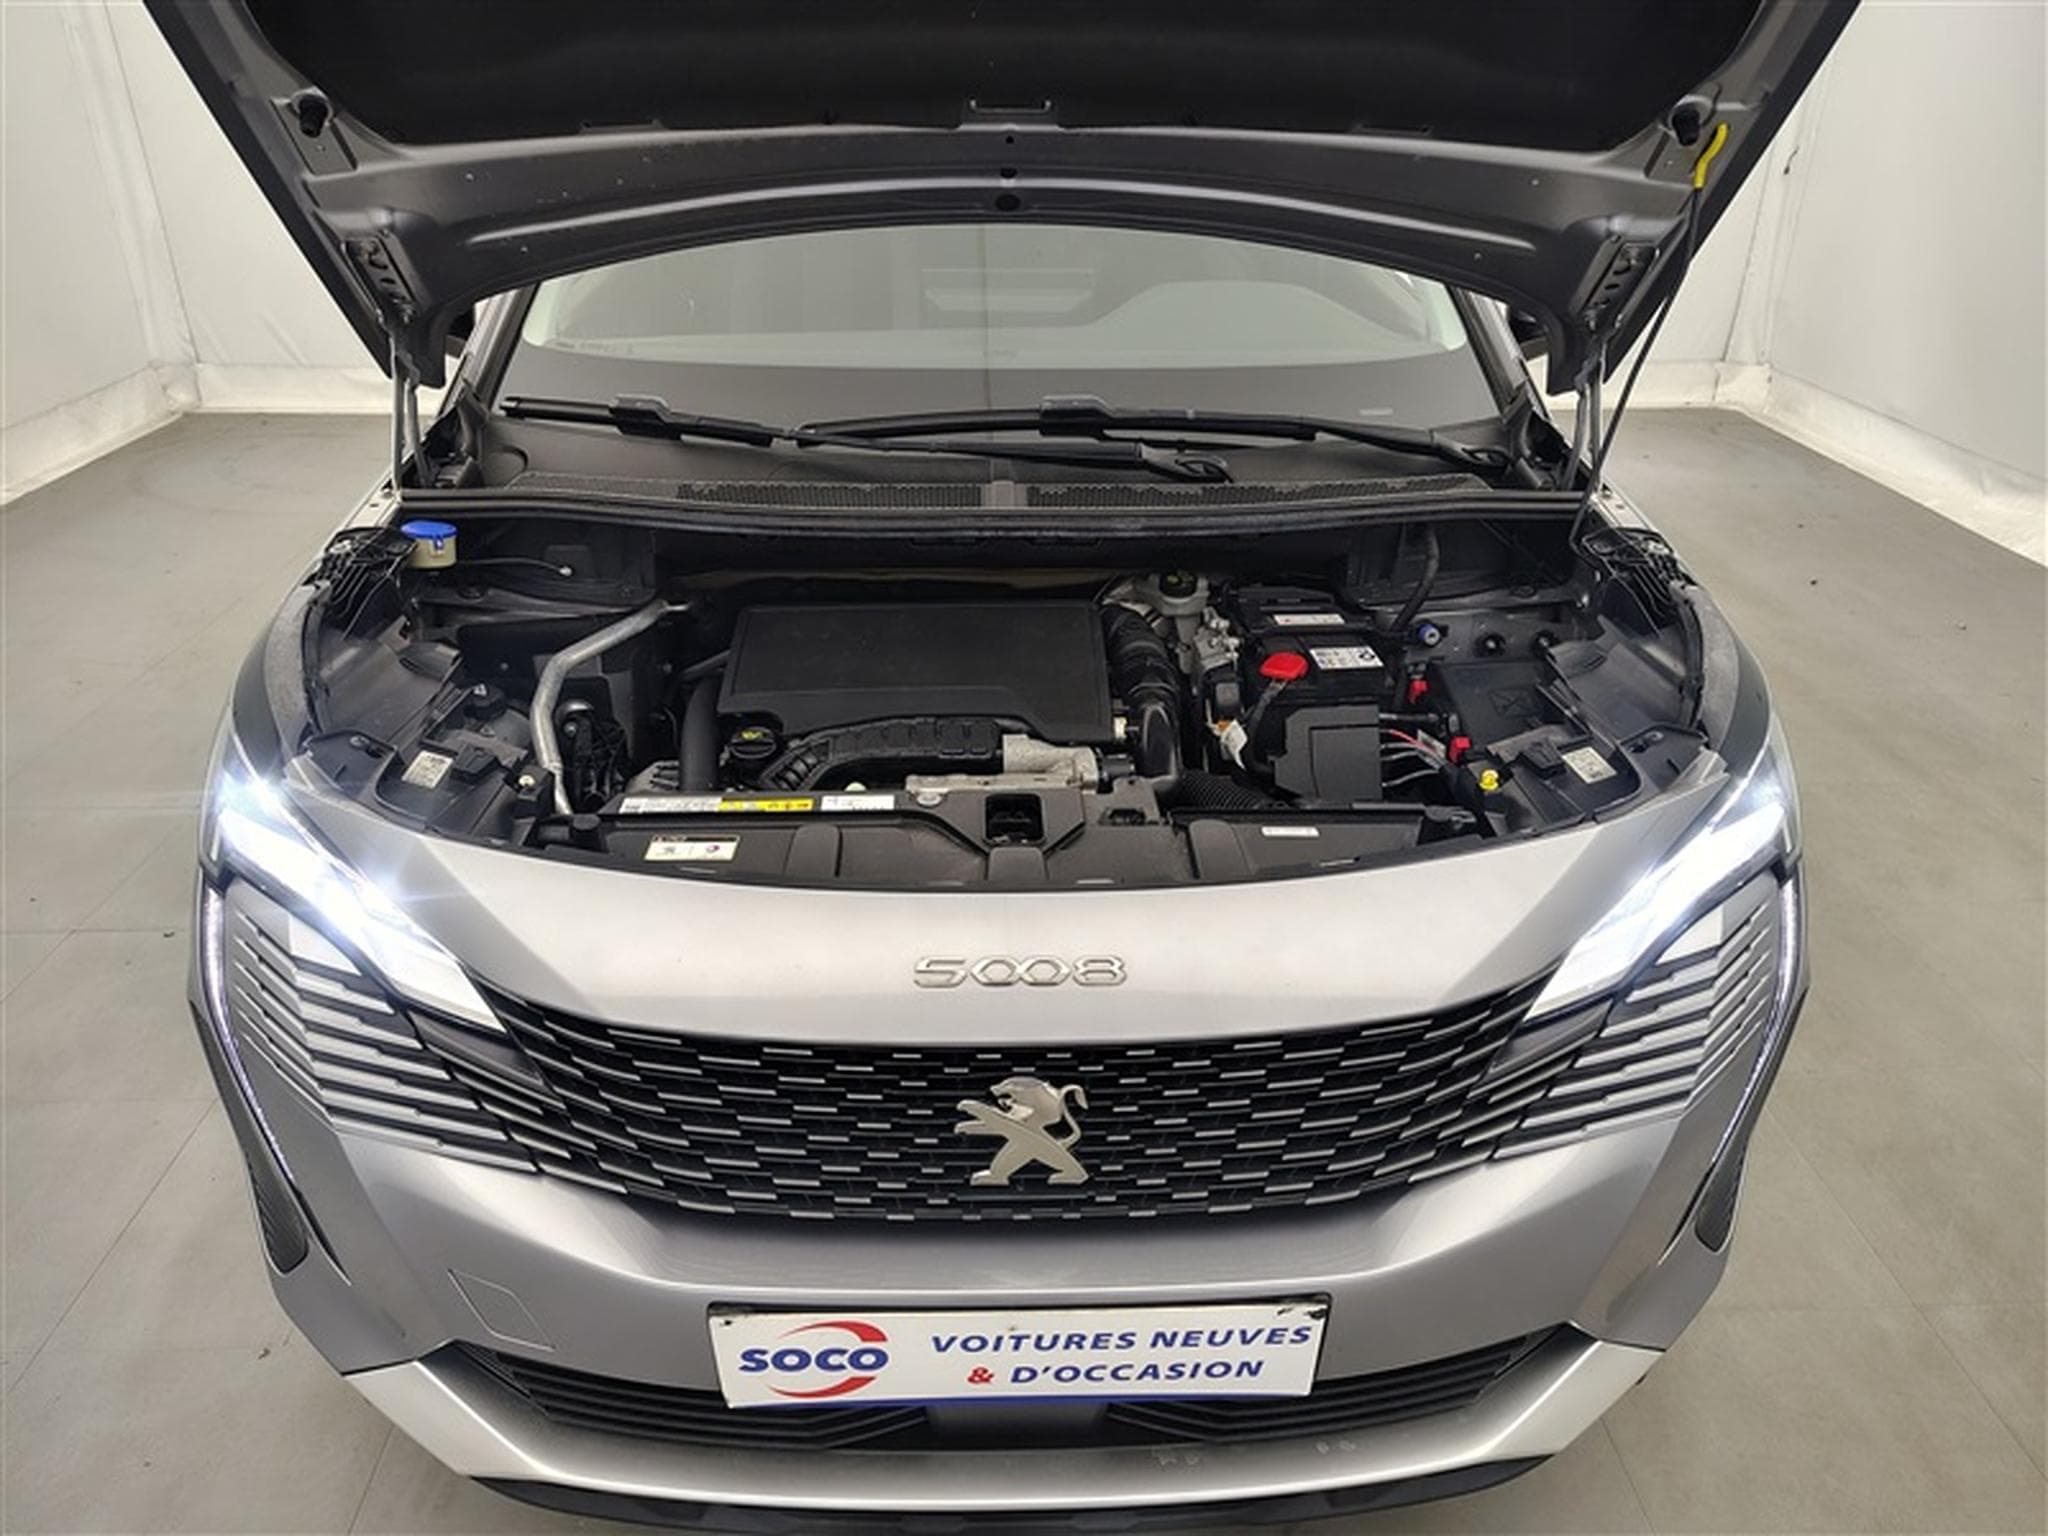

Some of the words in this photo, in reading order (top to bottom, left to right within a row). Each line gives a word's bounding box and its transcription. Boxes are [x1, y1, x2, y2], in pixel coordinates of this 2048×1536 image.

[913, 956, 1127, 988] 5008
[932, 1331, 1137, 1353] VOITURES
[1151, 1326, 1313, 1348] NEUVES
[738, 1347, 889, 1373] SOCO
[967, 1366, 995, 1385] &
[1010, 1361, 1264, 1384] D'OCCASION
